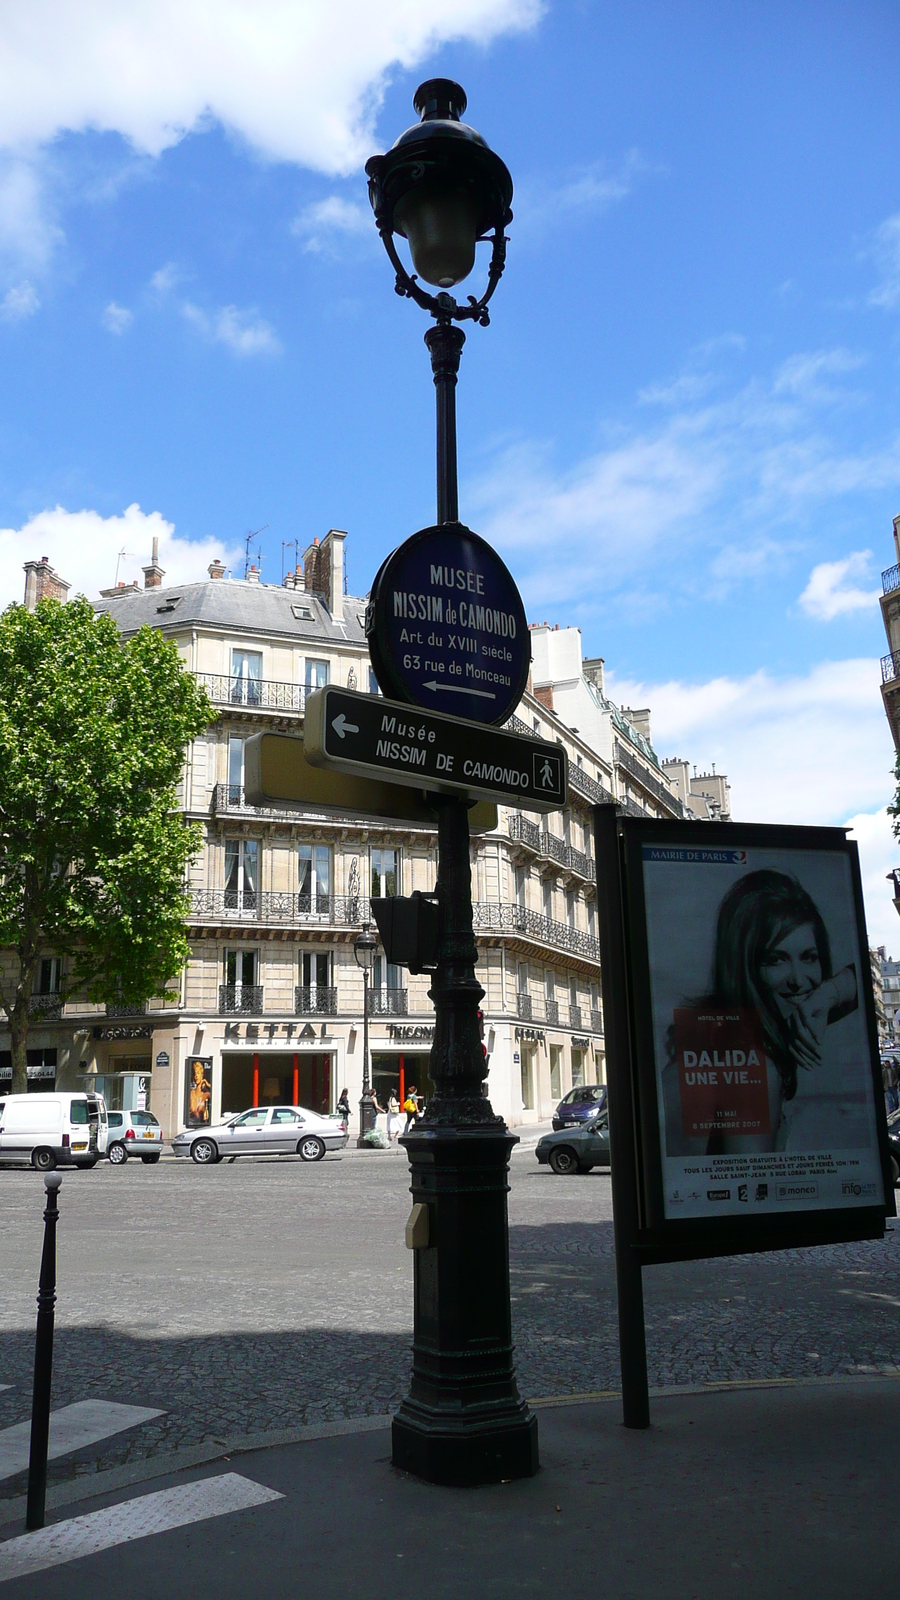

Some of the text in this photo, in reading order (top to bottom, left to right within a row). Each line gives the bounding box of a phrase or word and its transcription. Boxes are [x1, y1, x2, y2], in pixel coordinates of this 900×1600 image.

[430, 564, 485, 595] MUSÉE
[393, 591, 517, 639] NISSIM de CAMONDO
[399, 628, 513, 662] Art du XVIII siècle
[403, 654, 511, 686] 63 rue de Monceau
[380, 715, 436, 743] Musée
[375, 739, 530, 788] NISSIM DE CAMONDO
[650, 850, 728, 861] MAIRIE DE PARIS
[224, 1022, 335, 1039] KETTAL
[683, 1049, 761, 1068] DALIDA
[684, 1070, 762, 1086] UNE VIE...
[699, 1121, 740, 1129] SEPTEMBRE
[742, 1120, 761, 1128] 2007
[752, 1163, 786, 1171] DIMANCHES
